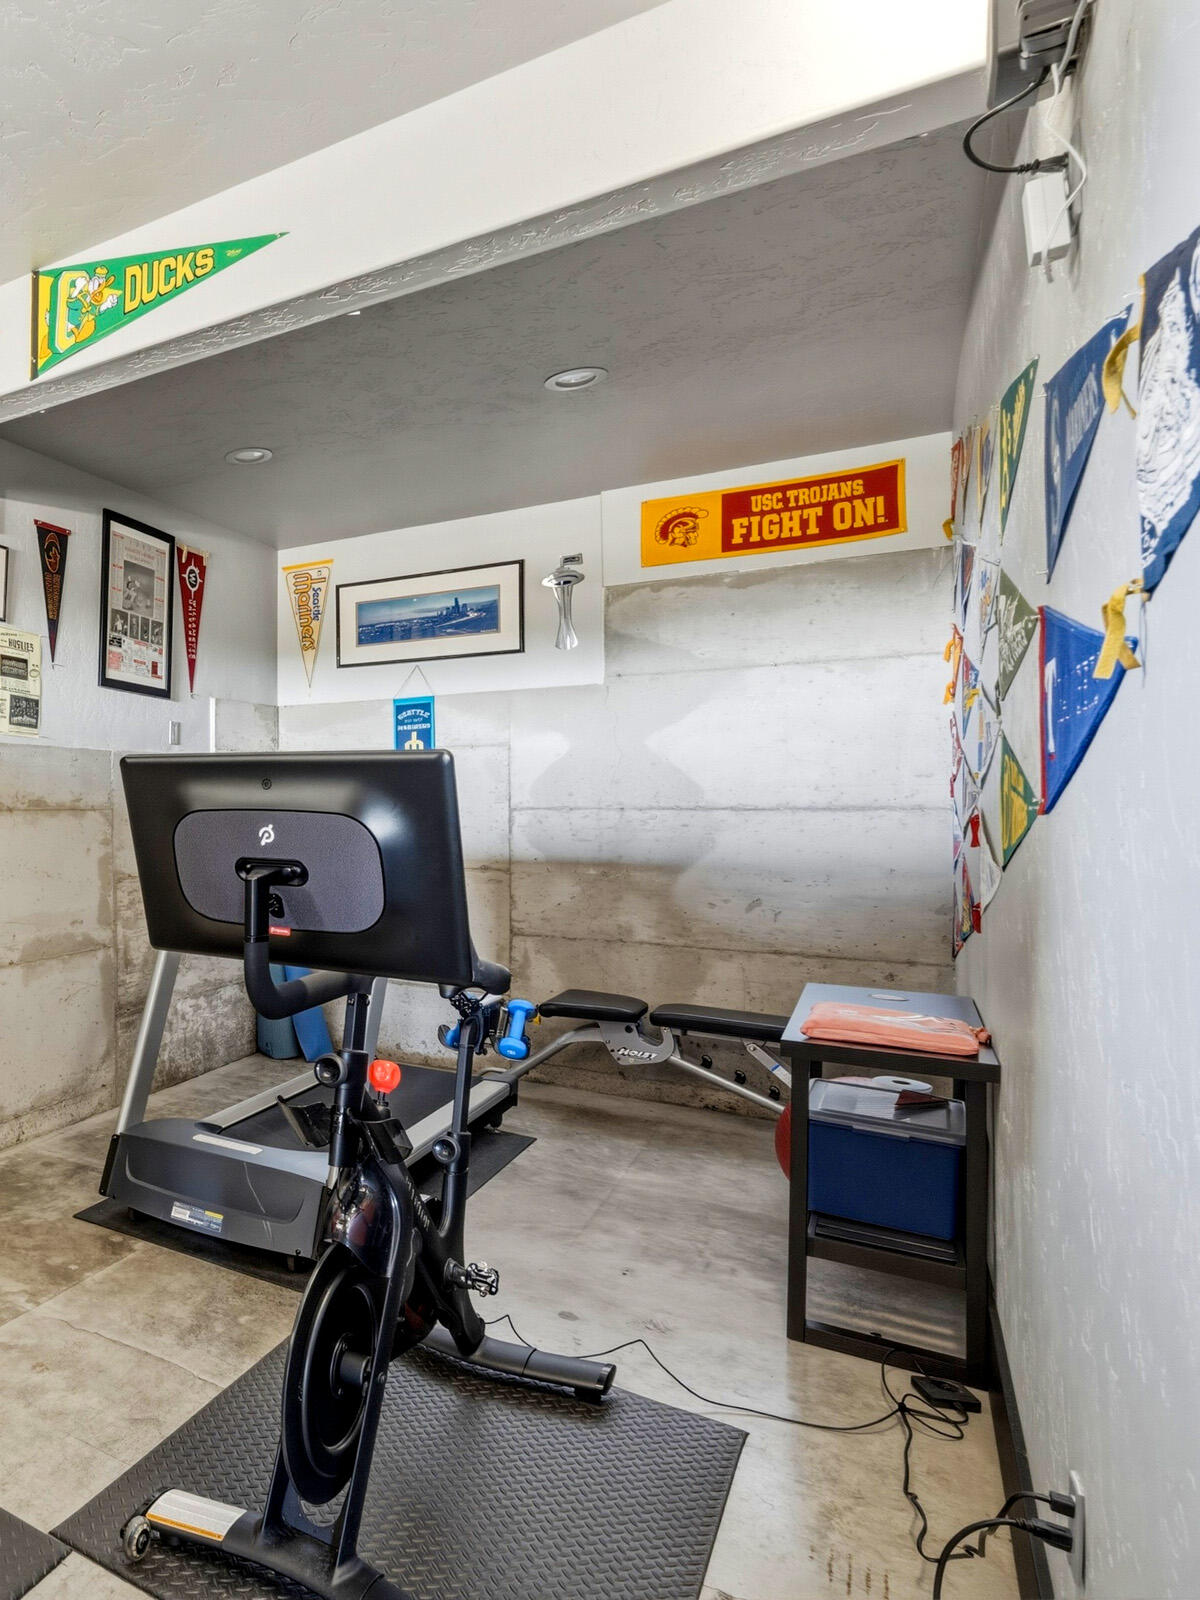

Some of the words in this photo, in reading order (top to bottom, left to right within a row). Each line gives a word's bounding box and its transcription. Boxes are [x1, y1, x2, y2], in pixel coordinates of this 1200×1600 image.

[123, 247, 215, 315] DUCKS
[750, 493, 783, 513] USC
[786, 479, 864, 508] TROJANS
[731, 507, 823, 544] FIGHT
[832, 495, 887, 531] ON!
[312, 587, 322, 621] Seattle
